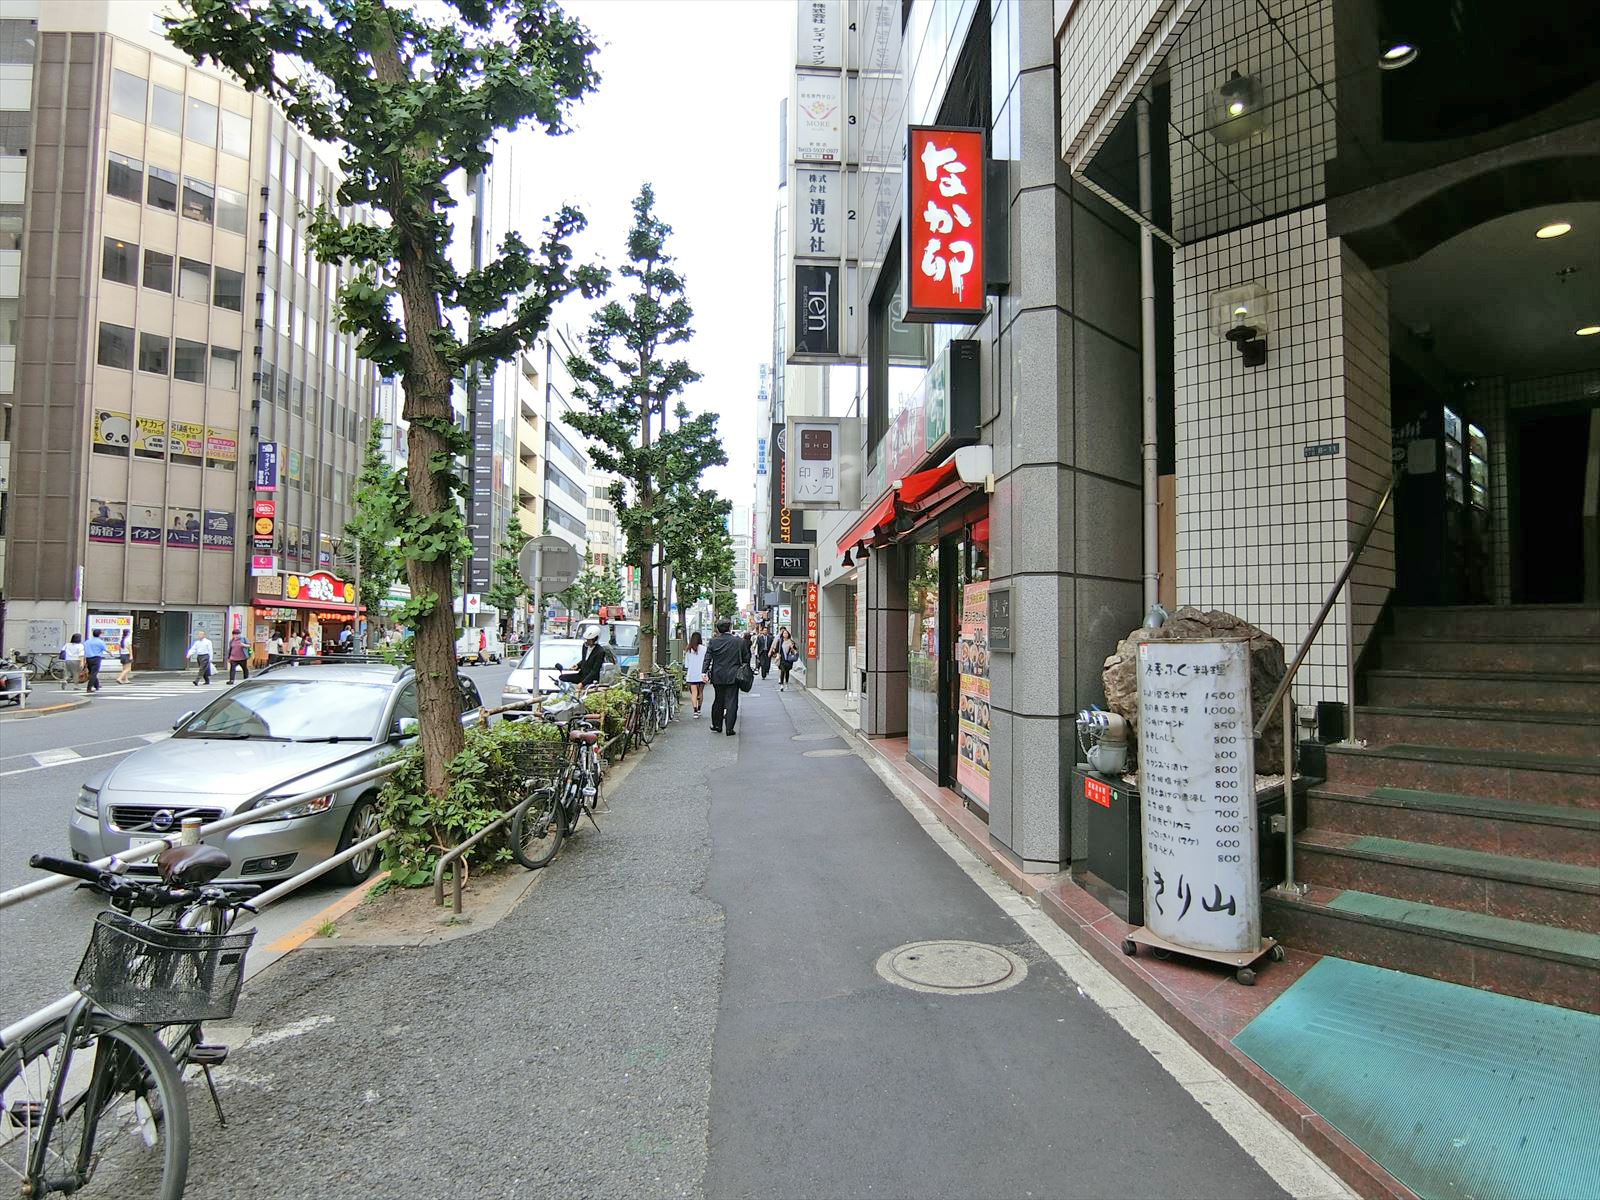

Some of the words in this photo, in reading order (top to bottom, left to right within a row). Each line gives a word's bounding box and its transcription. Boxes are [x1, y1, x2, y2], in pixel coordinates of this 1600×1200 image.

[848, 22, 857, 33] 4
[806, 120, 829, 128] MORE
[848, 115, 857, 125] 3
[848, 210, 856, 220] 2
[809, 198, 826, 253] 清光社
[921, 141, 975, 303] なか卯
[808, 278, 831, 340] Ten
[849, 306, 853, 316] 1
[799, 467, 834, 480] 印刷
[799, 484, 834, 495] ハンコ
[808, 585, 817, 656] 大きい靴の専門店
[1205, 692, 1235, 700] 1500
[1214, 736, 1237, 744] 800
[1214, 766, 1238, 774] 800
[1215, 780, 1238, 788] 800
[1214, 795, 1239, 803] 700
[1215, 810, 1239, 818] 700
[1215, 825, 1240, 833] 600
[1216, 840, 1240, 848] 600
[1217, 855, 1241, 863] 800
[1154, 866, 1236, 921] きり山
